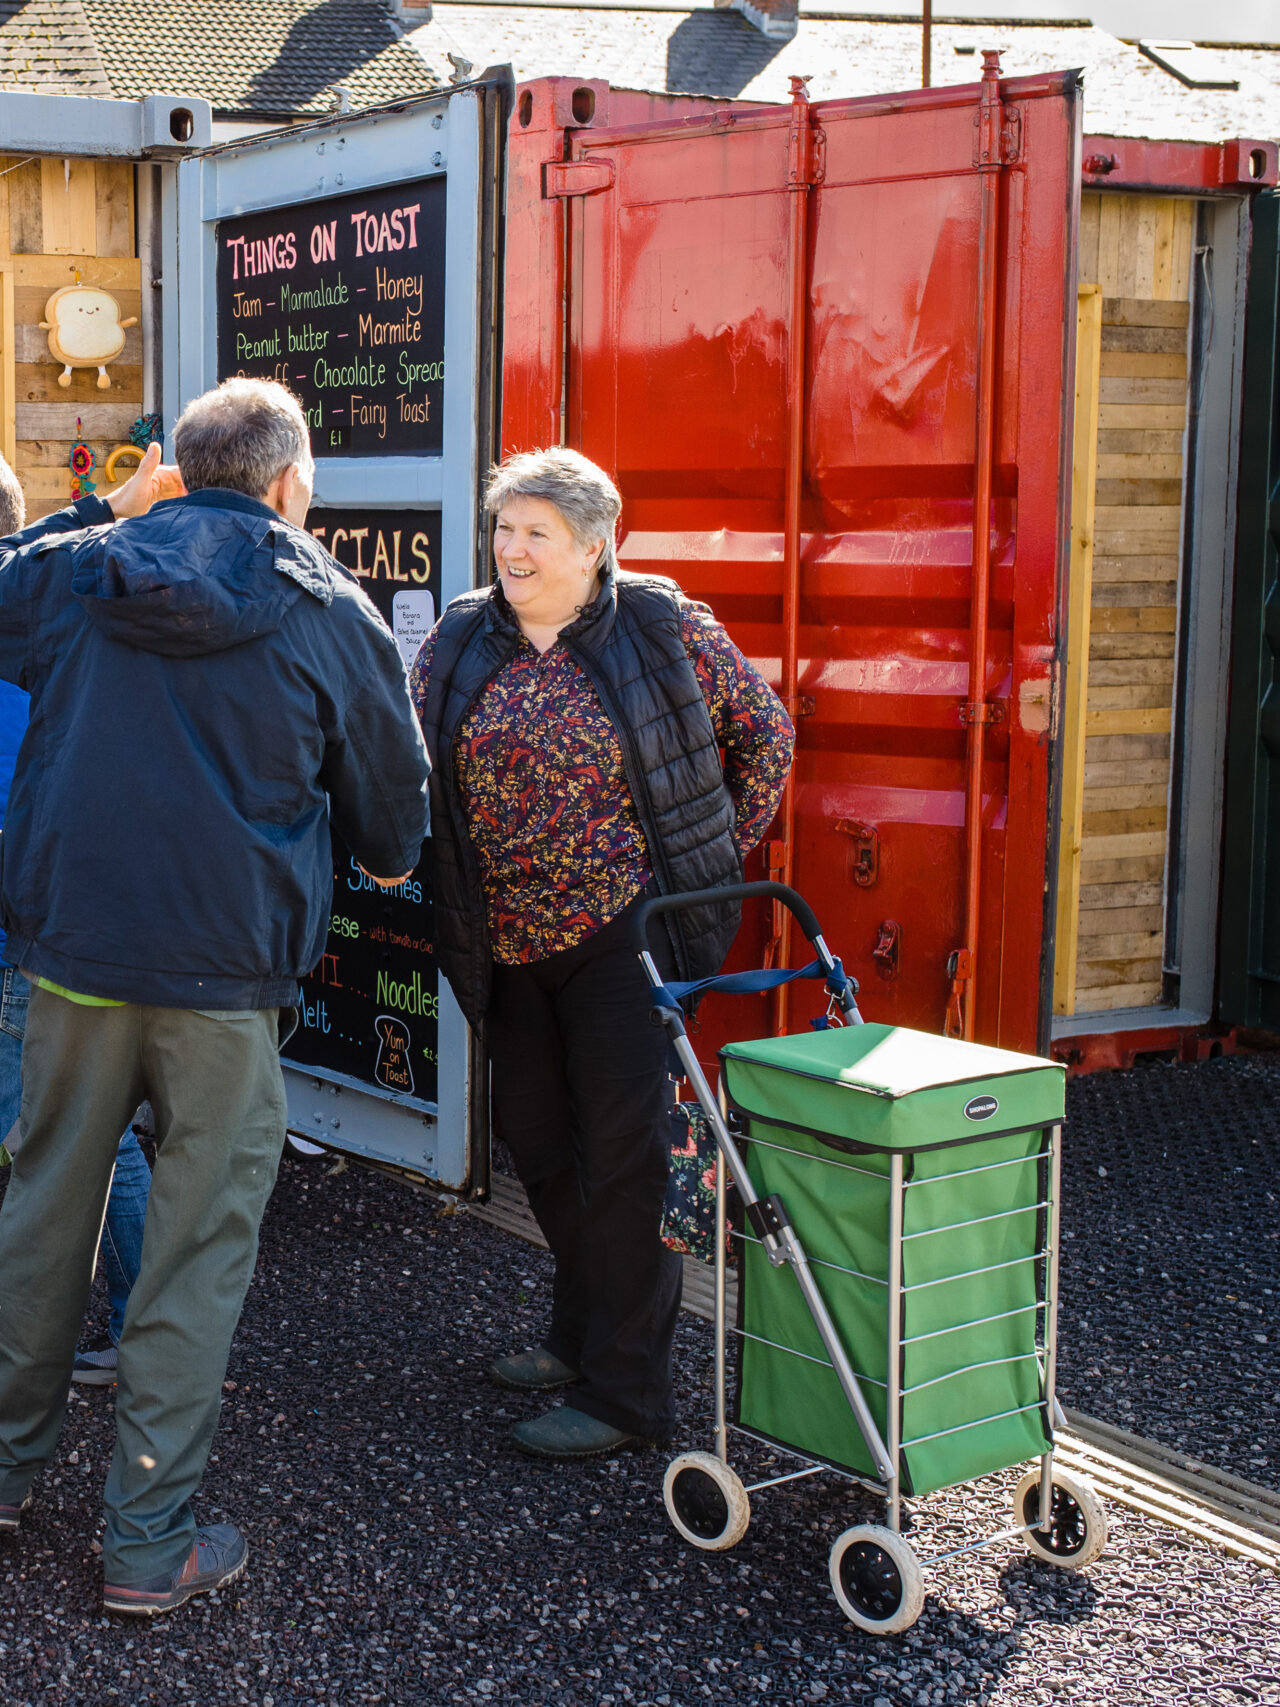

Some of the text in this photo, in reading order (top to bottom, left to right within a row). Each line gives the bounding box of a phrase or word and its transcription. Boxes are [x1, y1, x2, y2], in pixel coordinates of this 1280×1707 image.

[226, 203, 421, 280] THINGS ON TOAST
[233, 292, 262, 318] Jam
[281, 271, 349, 313] Marmalade
[376, 266, 423, 316] Honey
[236, 328, 282, 361] Peanut
[288, 323, 330, 352] butter
[358, 313, 422, 348] Marmite
[314, 355, 386, 389] Chocolate
[351, 394, 387, 438] Fairy
[396, 393, 431, 423] Toast
[369, 925, 387, 942] with
[376, 970, 438, 1020] Noodles
[384, 1024, 405, 1052] Yum
[382, 1062, 409, 1085] Toast
[390, 1052, 400, 1064] on
